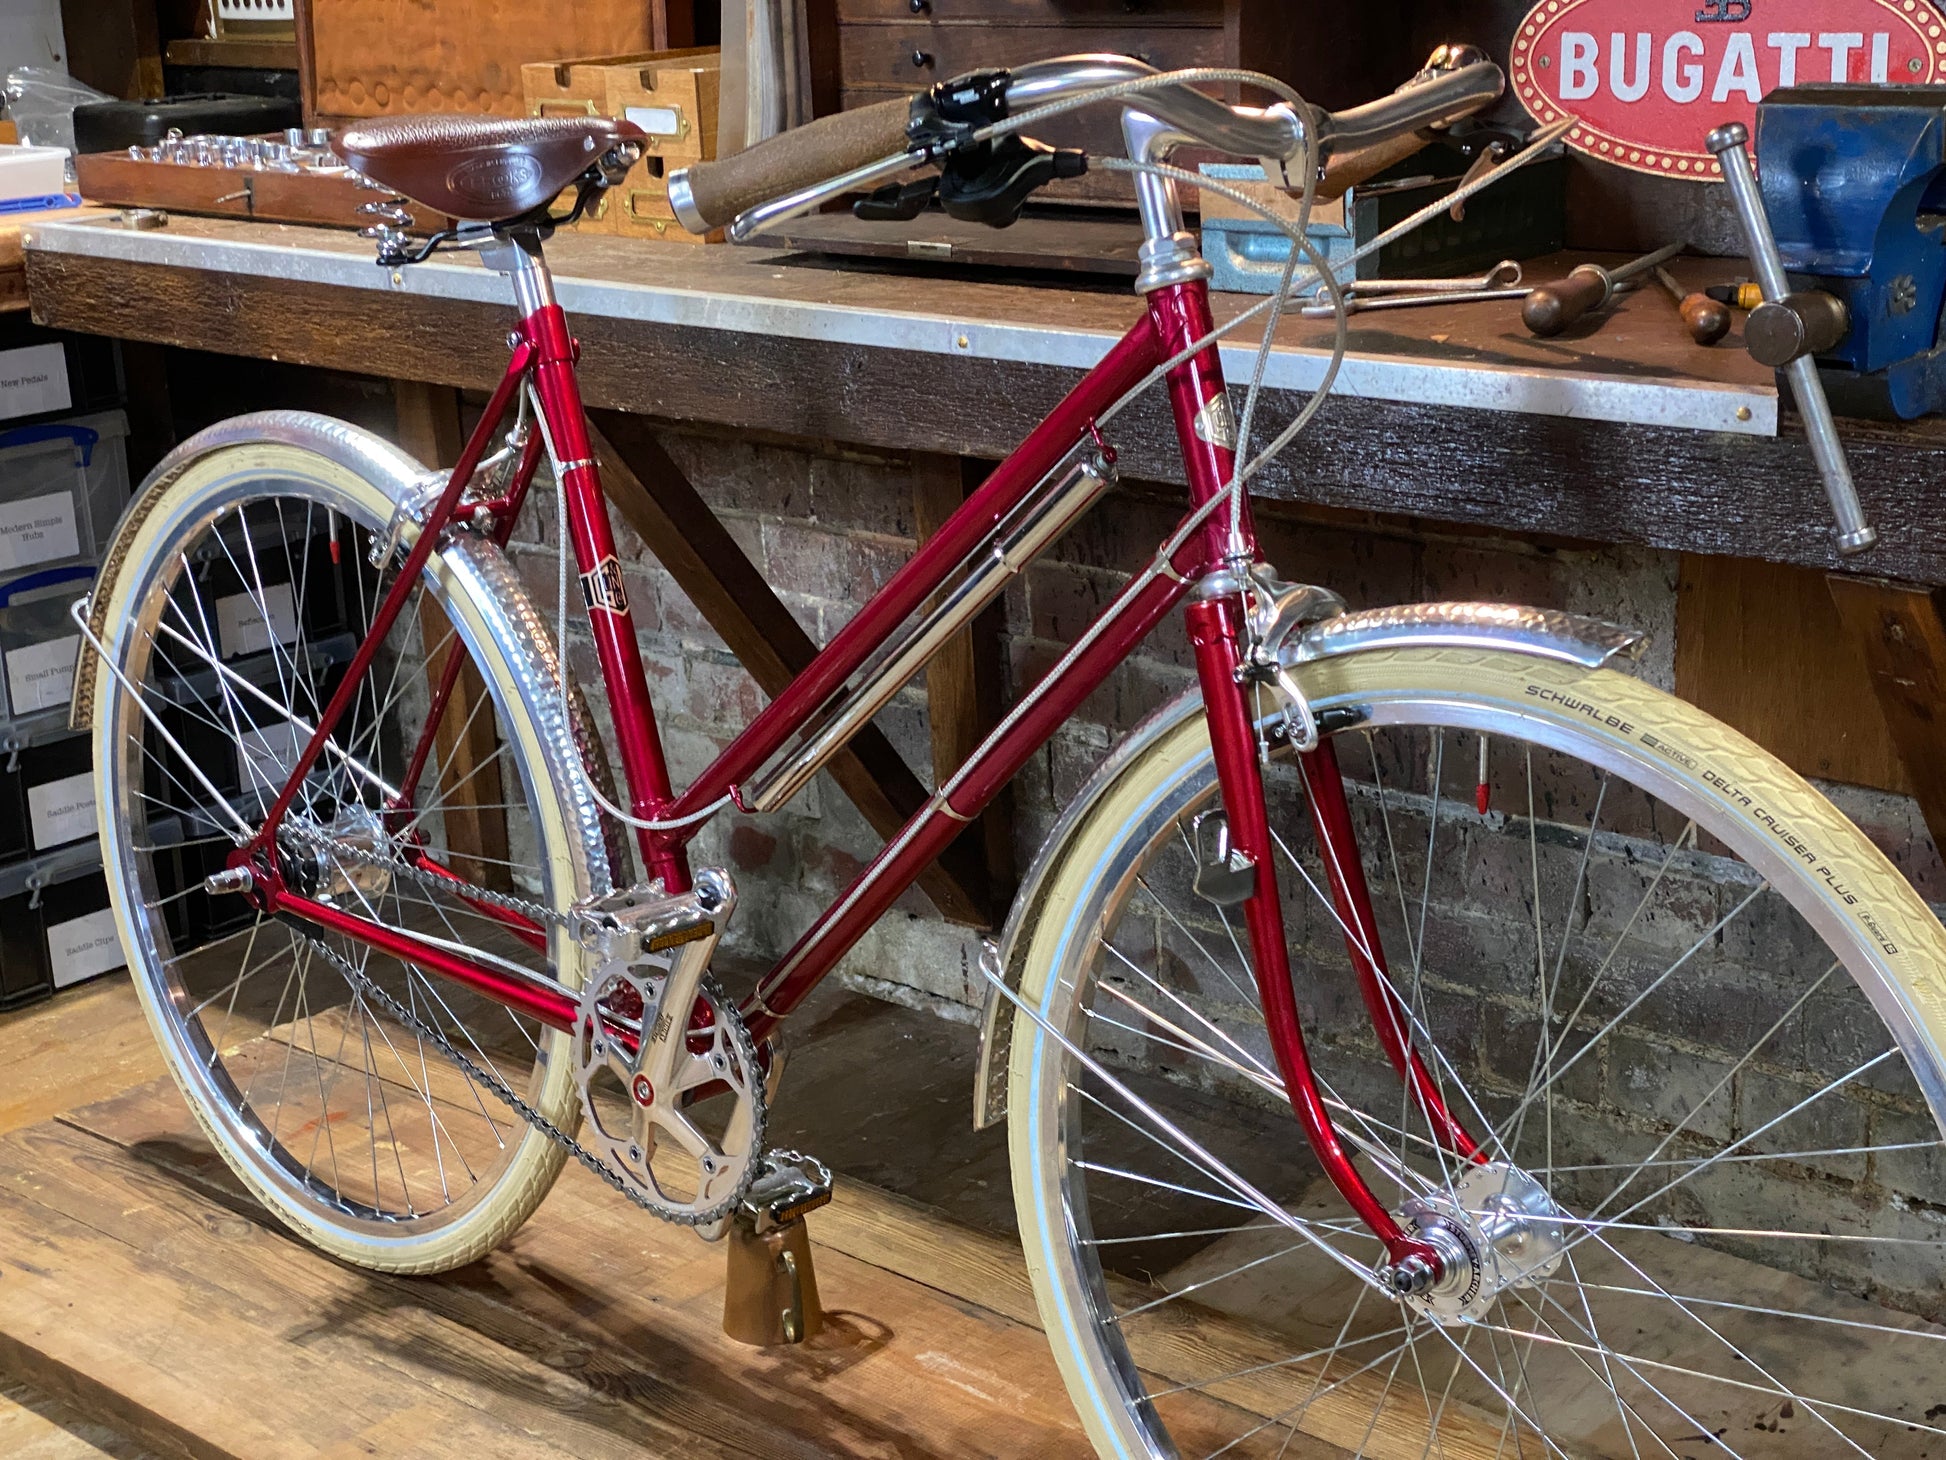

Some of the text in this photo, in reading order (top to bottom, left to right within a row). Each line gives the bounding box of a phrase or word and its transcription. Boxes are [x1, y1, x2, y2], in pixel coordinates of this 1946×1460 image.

[1559, 31, 1889, 103] BUGATTI
[1524, 684, 1634, 736] SCHWALBE
[1656, 743, 1691, 768] ACTIVE
[1702, 769, 1859, 907] DELTA CRUISER PLUS
